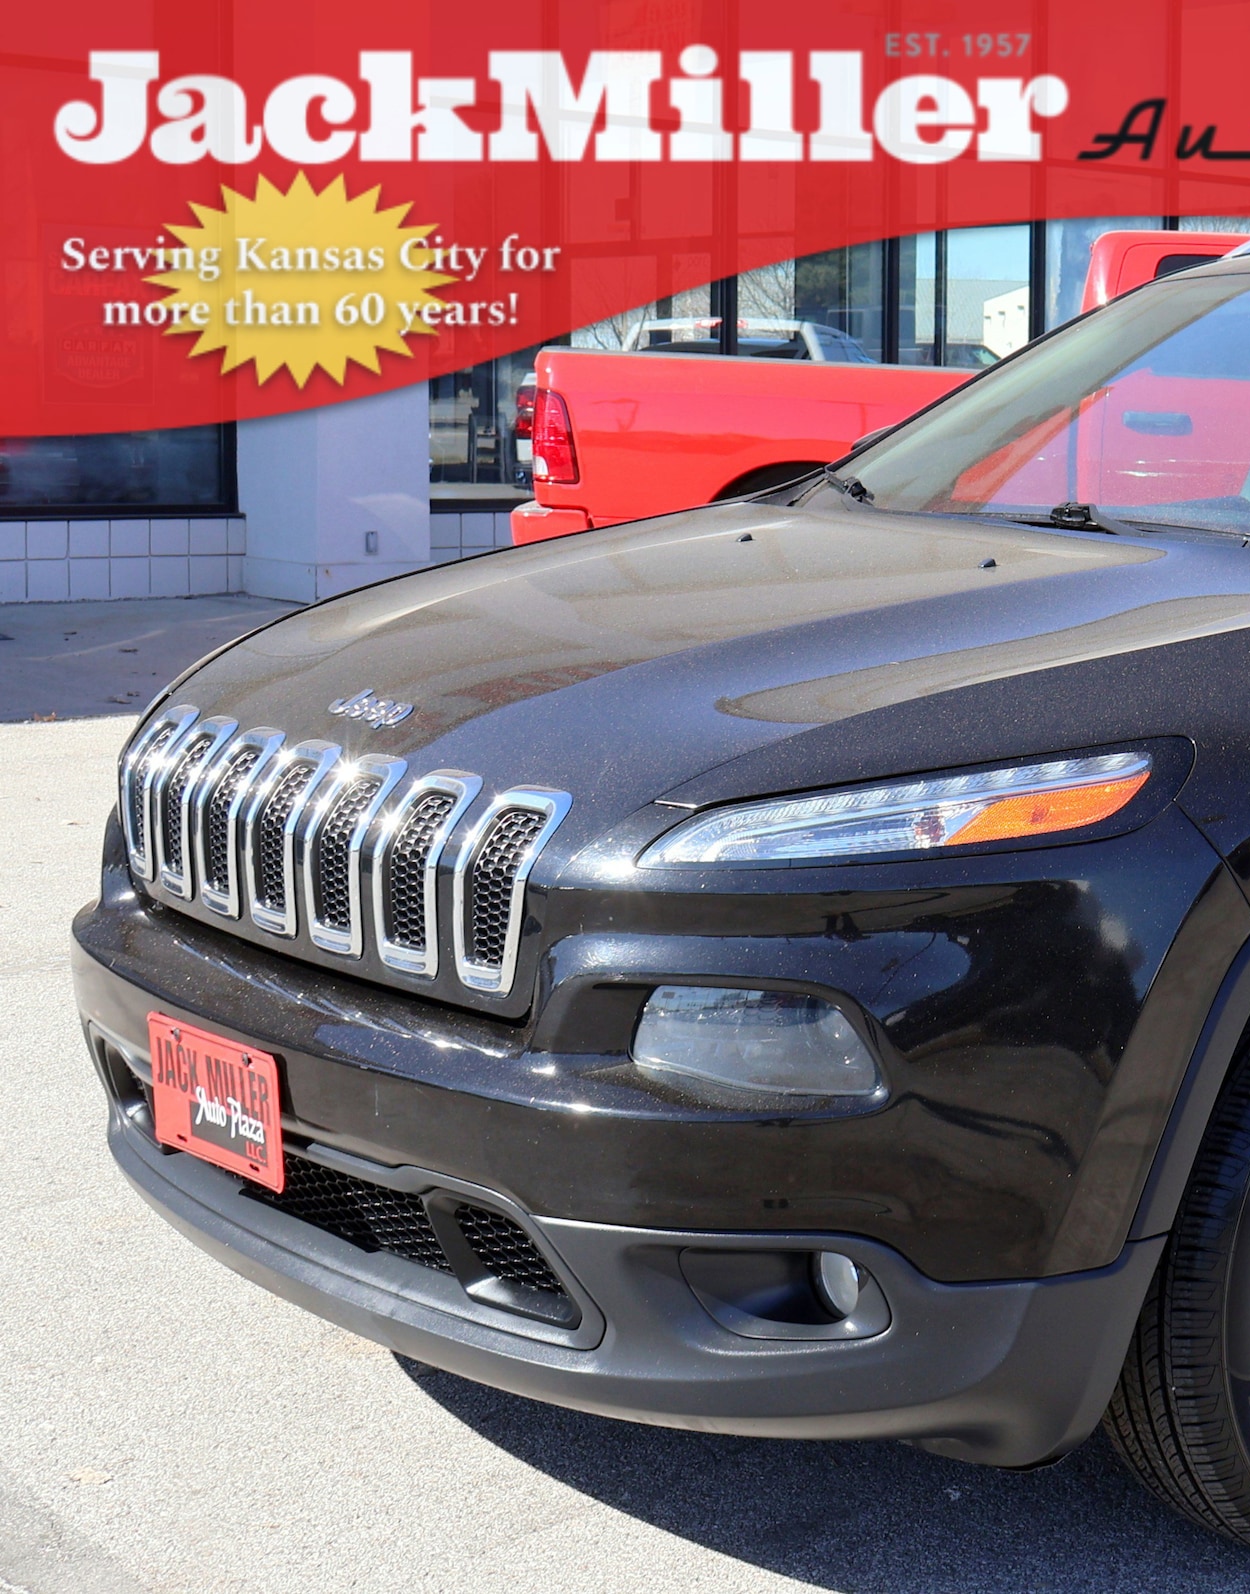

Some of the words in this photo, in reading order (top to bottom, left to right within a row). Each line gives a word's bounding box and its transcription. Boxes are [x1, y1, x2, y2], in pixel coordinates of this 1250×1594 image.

[328, 688, 414, 730] Jeep
[156, 1036, 201, 1097] JACK
[205, 1055, 272, 1127] MILLER
[195, 1085, 227, 1128] Auto
[227, 1096, 265, 1145] Plaza
